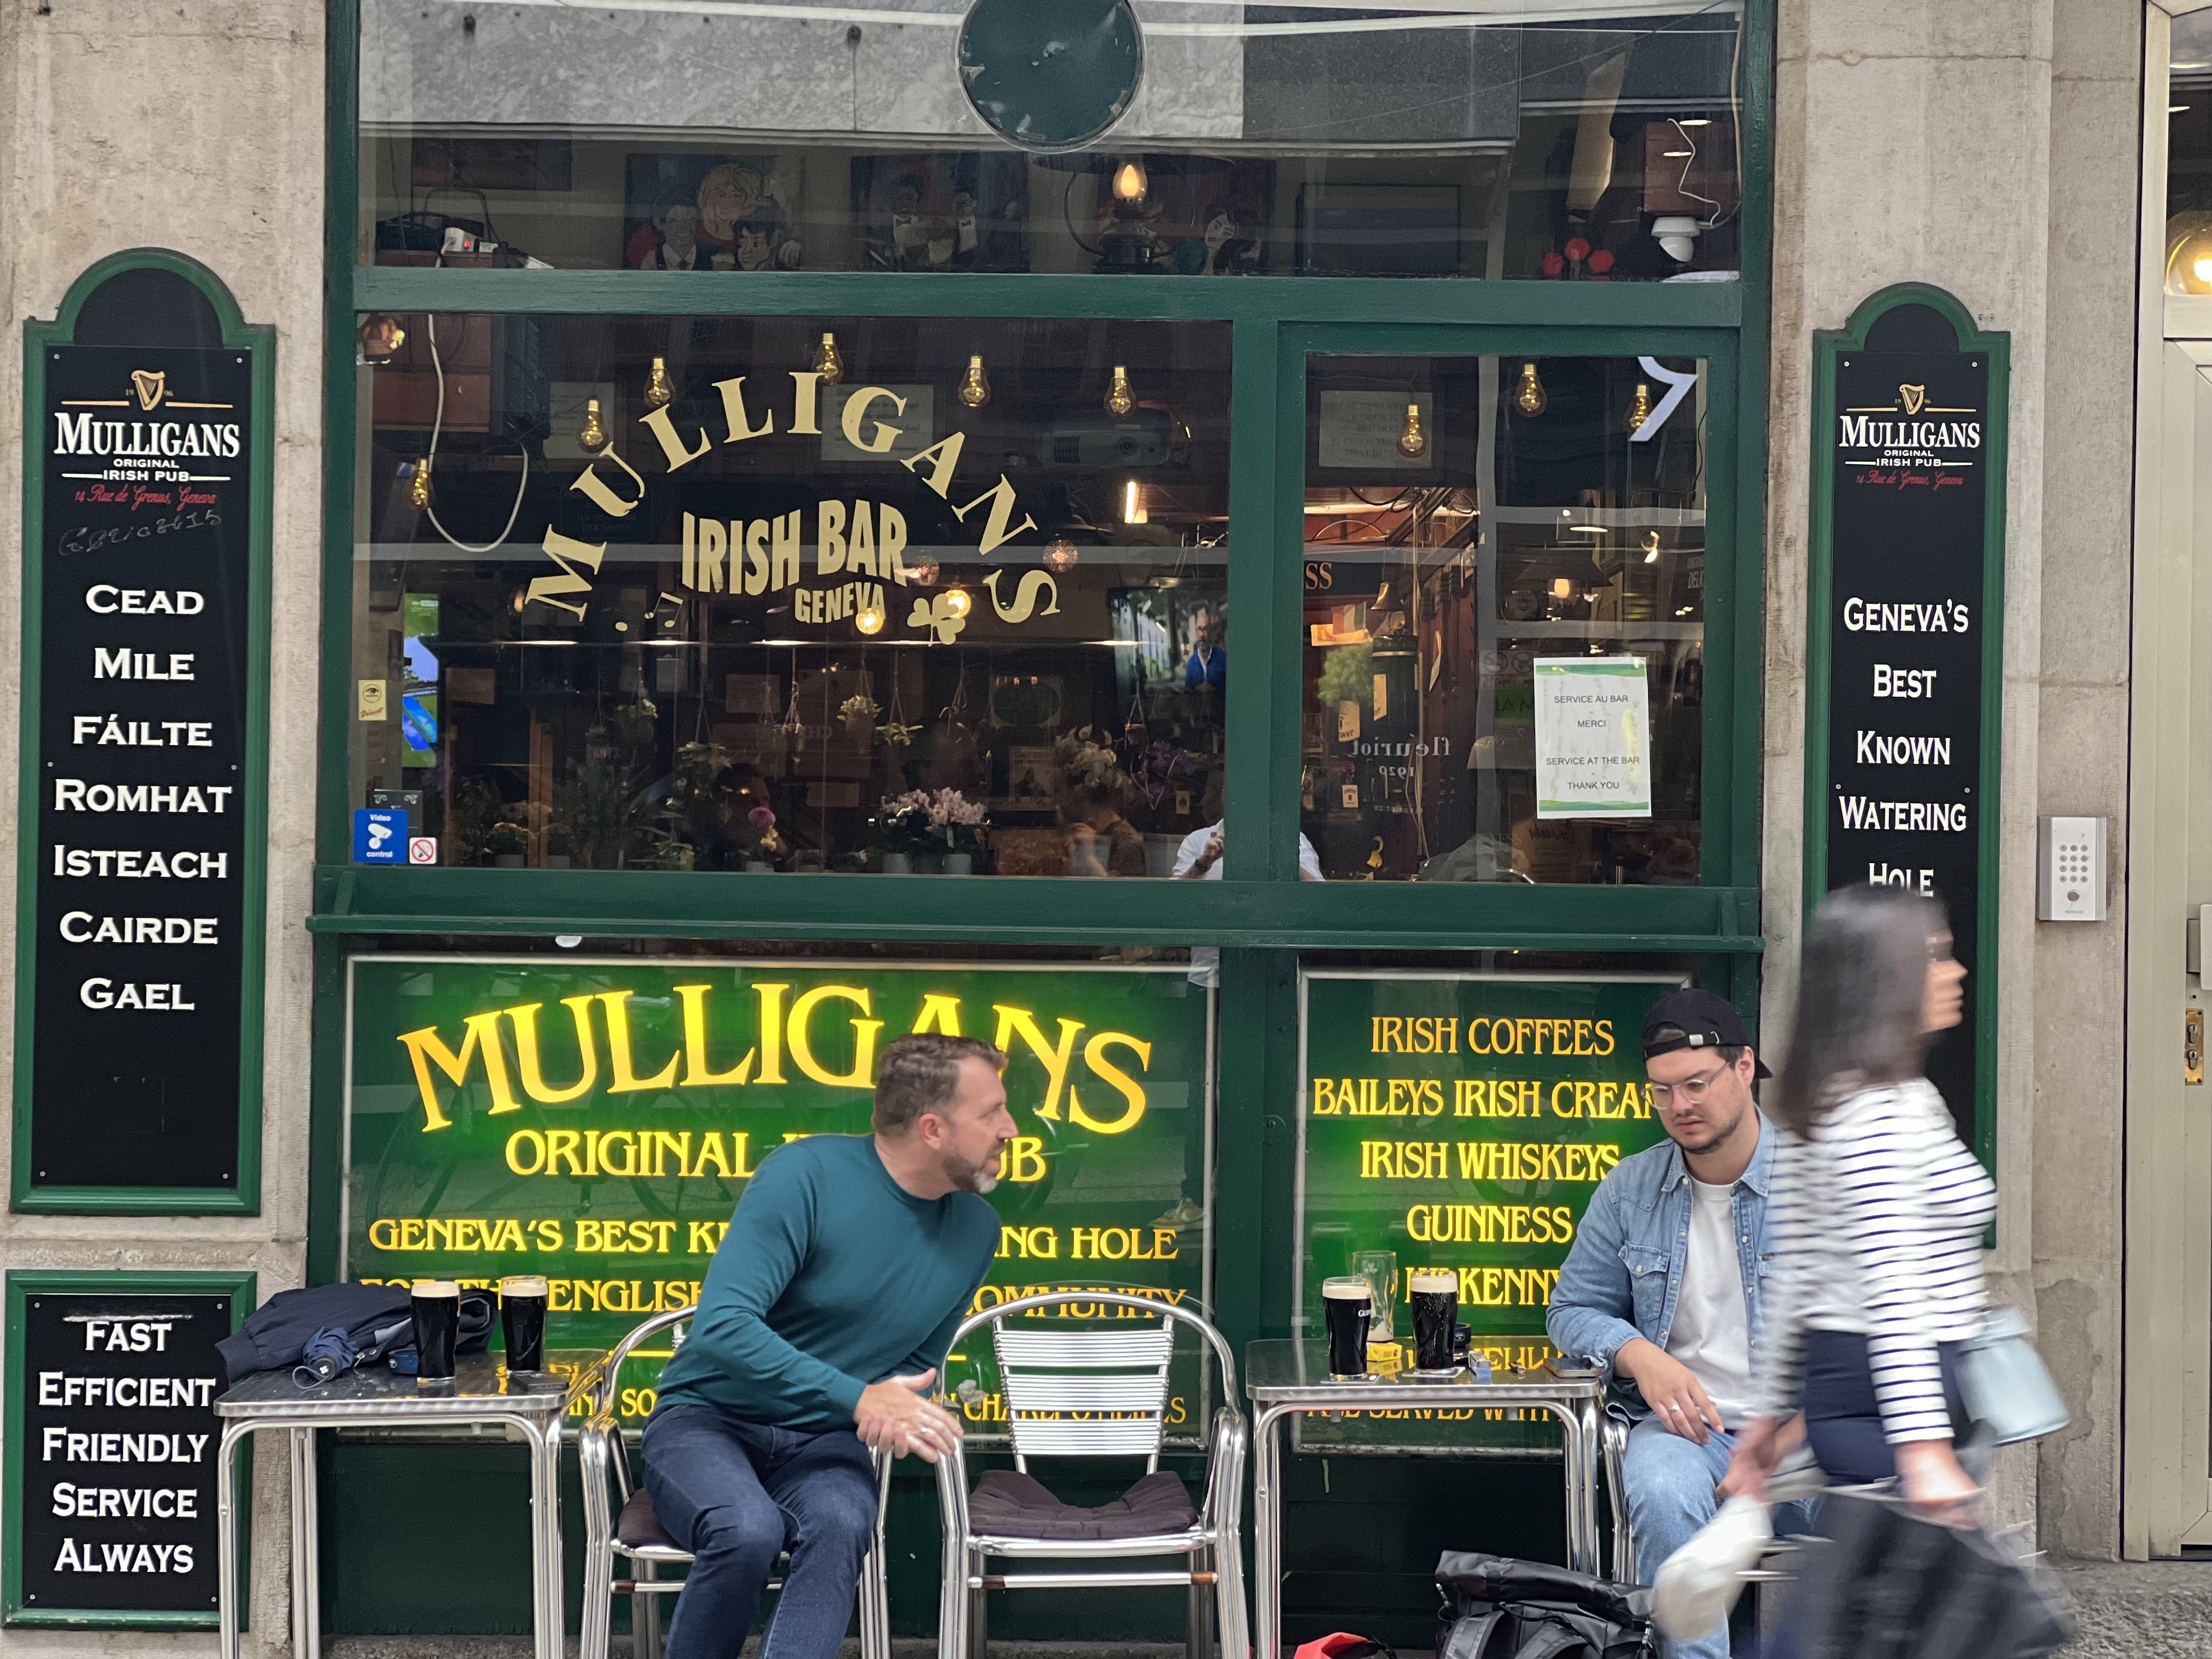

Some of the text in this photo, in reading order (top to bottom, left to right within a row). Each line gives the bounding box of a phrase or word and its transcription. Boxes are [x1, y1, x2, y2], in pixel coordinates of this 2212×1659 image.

[54, 413, 239, 457] MULLIGANS
[1839, 415, 1980, 448] MULLIGANS
[103, 470, 190, 482] IRISH PUB
[114, 459, 179, 468] ORIGINAL
[1865, 470, 1886, 484] Rue
[1887, 470, 1896, 484] de
[87, 484, 112, 502] Rue
[115, 484, 128, 502] de
[524, 371, 1060, 624] MULLIGANS
[682, 510, 802, 596] IRISH
[818, 500, 907, 588] BAR
[86, 585, 204, 614] CEAD
[794, 582, 885, 624] GENEVA
[1844, 597, 1968, 632] GENEVA'S
[94, 648, 194, 680] MILE
[1874, 664, 1936, 698] BEST
[74, 714, 212, 747] FÁILTE
[1857, 731, 1950, 765] KNOWN
[55, 779, 232, 812] ROMHAT
[1839, 796, 1966, 831] WATERING
[54, 845, 227, 878] ISTEACH
[1868, 862, 1934, 898] HOLE
[60, 911, 217, 944] CAIRDE
[81, 978, 194, 1010] GAEL
[1372, 1017, 1614, 1055] IRISH COFFEES
[1314, 1079, 1443, 1116] BAILEYS
[1454, 1080, 1541, 1117] IRISH
[506, 1130, 754, 1177] ORIGINAL
[1361, 1141, 1620, 1181] IRISH WHISKEYS
[370, 1220, 563, 1251] GENEVA'S
[575, 1221, 676, 1252] BEST
[1407, 1205, 1572, 1243] GUINNESS
[1071, 1228, 1178, 1259] HOLE
[85, 1321, 172, 1351] FAST
[39, 1372, 216, 1407] EFFICIENT
[43, 1427, 208, 1463] FRIENDLY
[53, 1482, 196, 1518] SERVICE
[54, 1538, 193, 1573] ALWAYS
